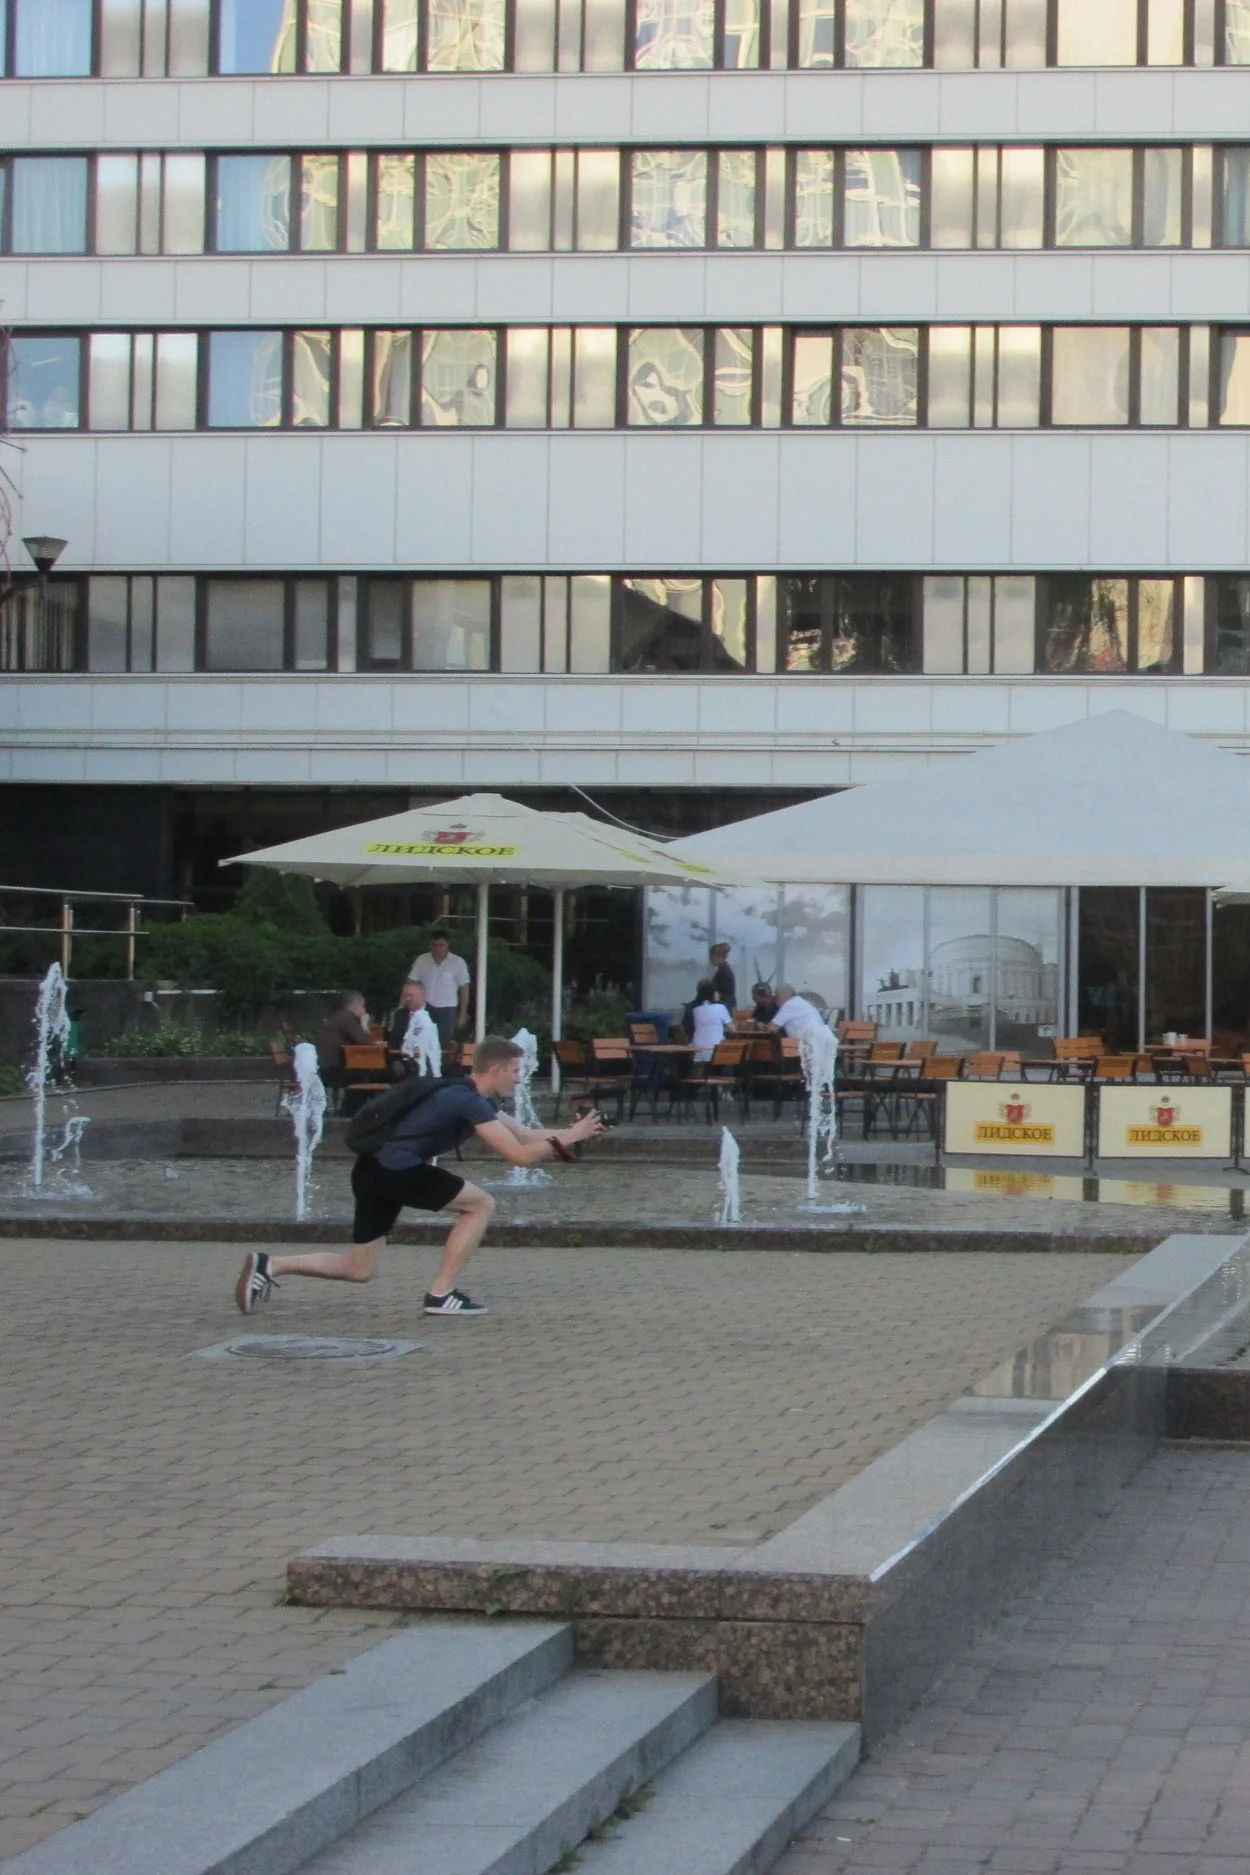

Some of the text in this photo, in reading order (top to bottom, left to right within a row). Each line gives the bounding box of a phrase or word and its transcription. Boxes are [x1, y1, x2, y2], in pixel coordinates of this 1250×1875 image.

[372, 843, 516, 857] ЛИДСКОЕ
[977, 1126, 1052, 1141] ЛИДСКОЕ
[1131, 1129, 1201, 1143] ЛИДСКОЕ
